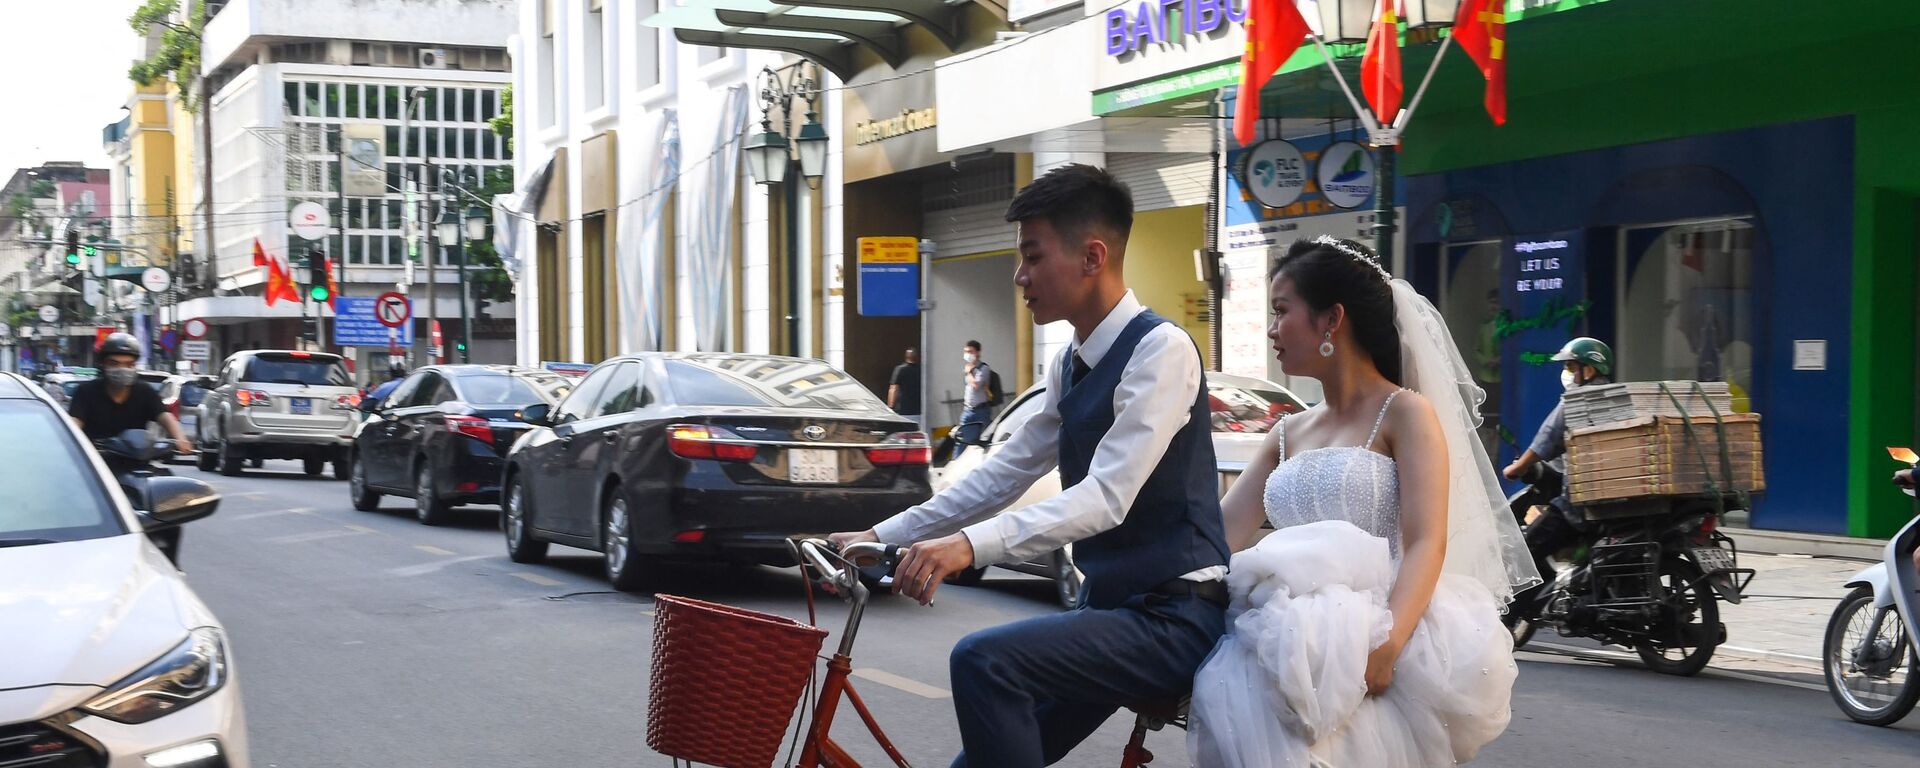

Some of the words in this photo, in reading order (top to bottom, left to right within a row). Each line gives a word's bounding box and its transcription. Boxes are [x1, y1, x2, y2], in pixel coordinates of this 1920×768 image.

[1106, 0, 1247, 56] BAMBO
[1276, 158, 1299, 170] FLC
[1325, 183, 1369, 193] BAMBOO
[1520, 259, 1541, 272] LET
[1543, 257, 1560, 270] US
[1516, 279, 1532, 292] BE
[1534, 277, 1563, 290] YOUR
